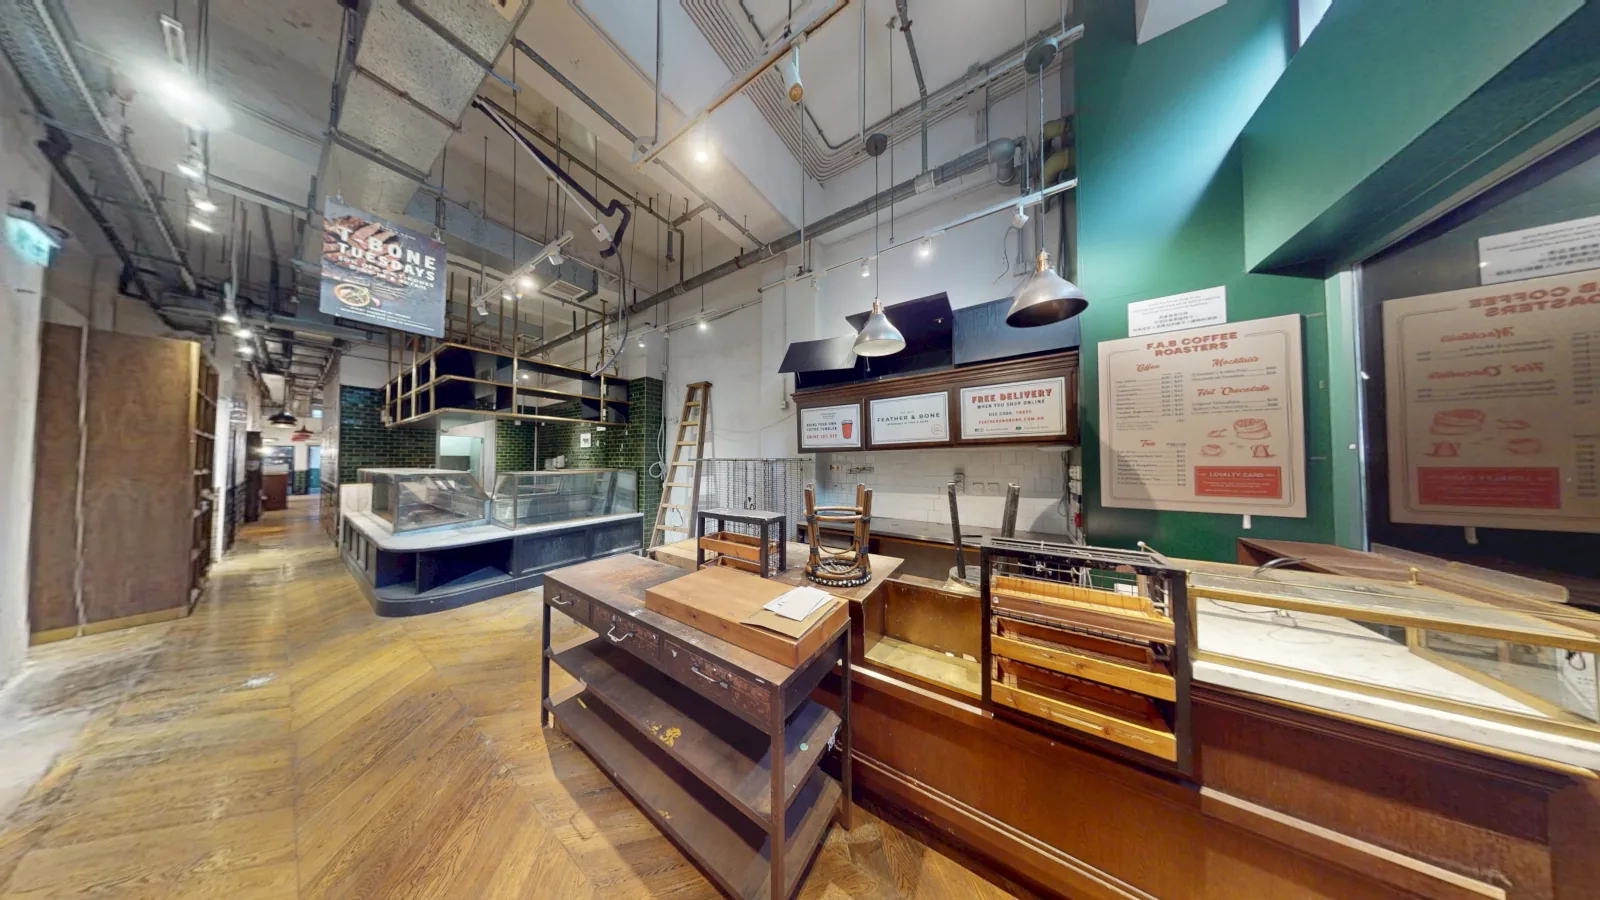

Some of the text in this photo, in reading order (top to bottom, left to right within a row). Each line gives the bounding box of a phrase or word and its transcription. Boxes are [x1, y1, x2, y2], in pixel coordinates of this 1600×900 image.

[338, 226, 436, 272] T-BONE
[338, 242, 436, 282] TUESDAYS
[1146, 332, 1238, 350] F.A.B COFFEE
[1155, 342, 1228, 357] ROASTERS
[1136, 364, 1160, 372] Coffee
[1212, 356, 1260, 367] Mocktails
[972, 388, 1052, 404] FREE DELIVERY
[1197, 384, 1270, 397] Hot Chocolate
